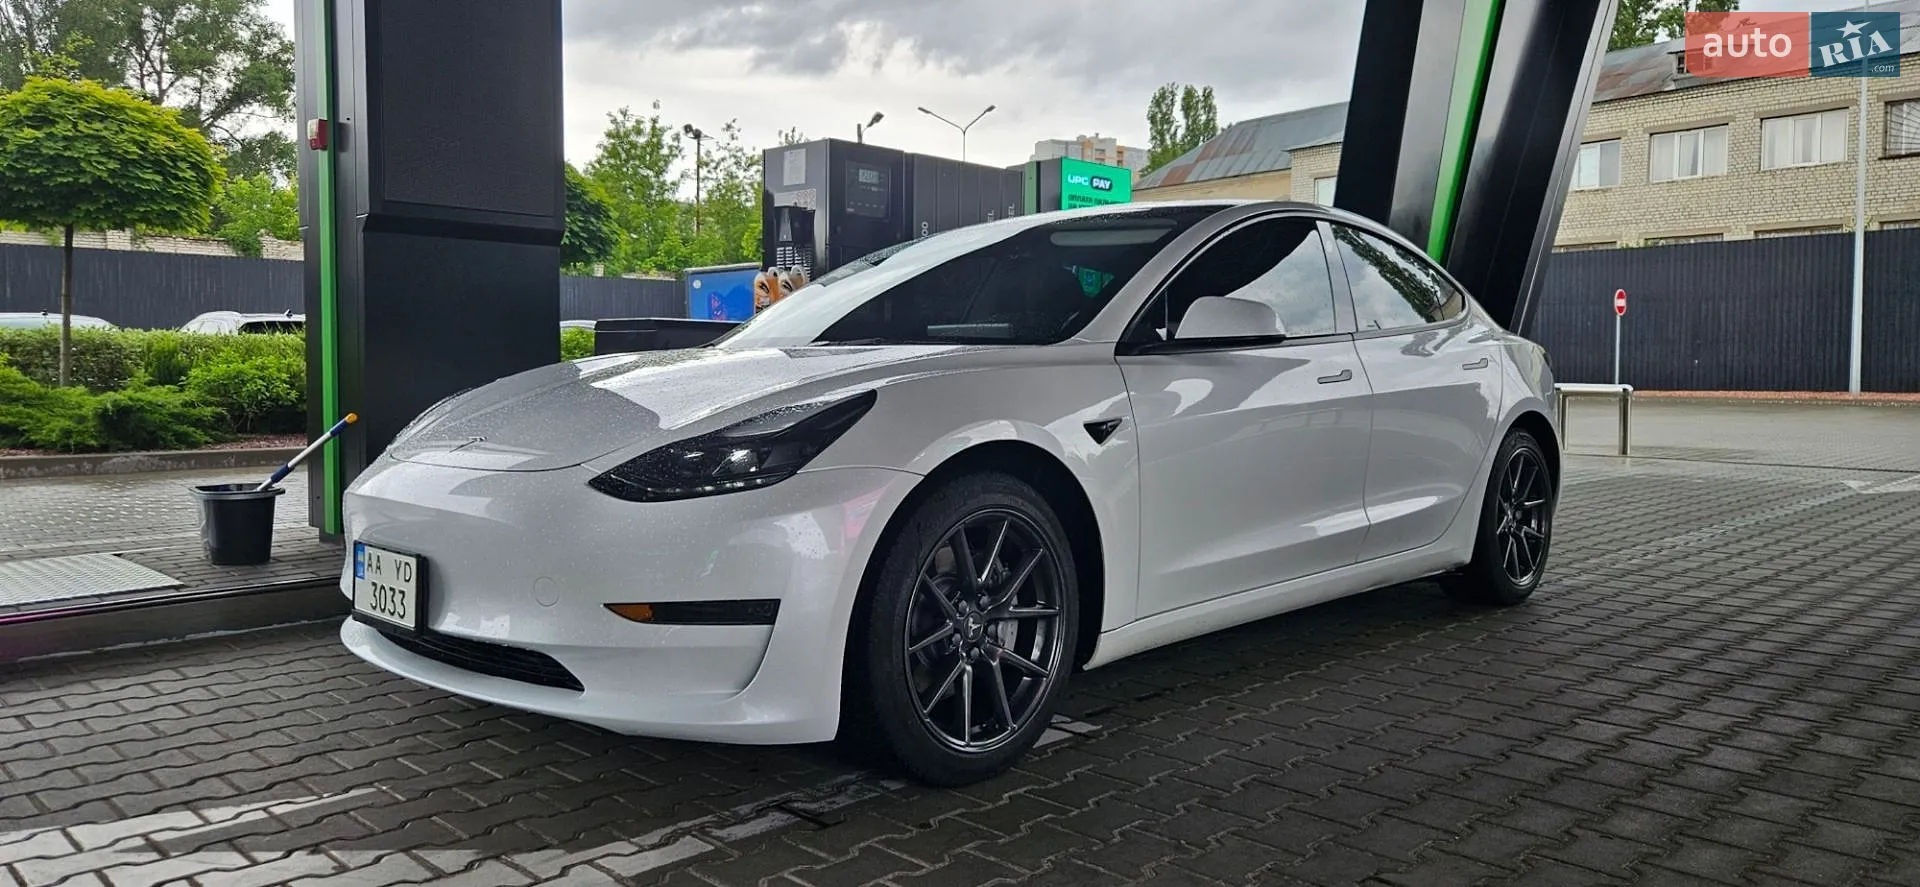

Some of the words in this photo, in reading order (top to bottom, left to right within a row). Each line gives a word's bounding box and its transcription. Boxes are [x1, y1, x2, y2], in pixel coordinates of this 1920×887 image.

[1092, 178, 1111, 189] PAY
[367, 552, 382, 575] AA
[394, 559, 412, 583] YD
[370, 581, 406, 619] 3033
